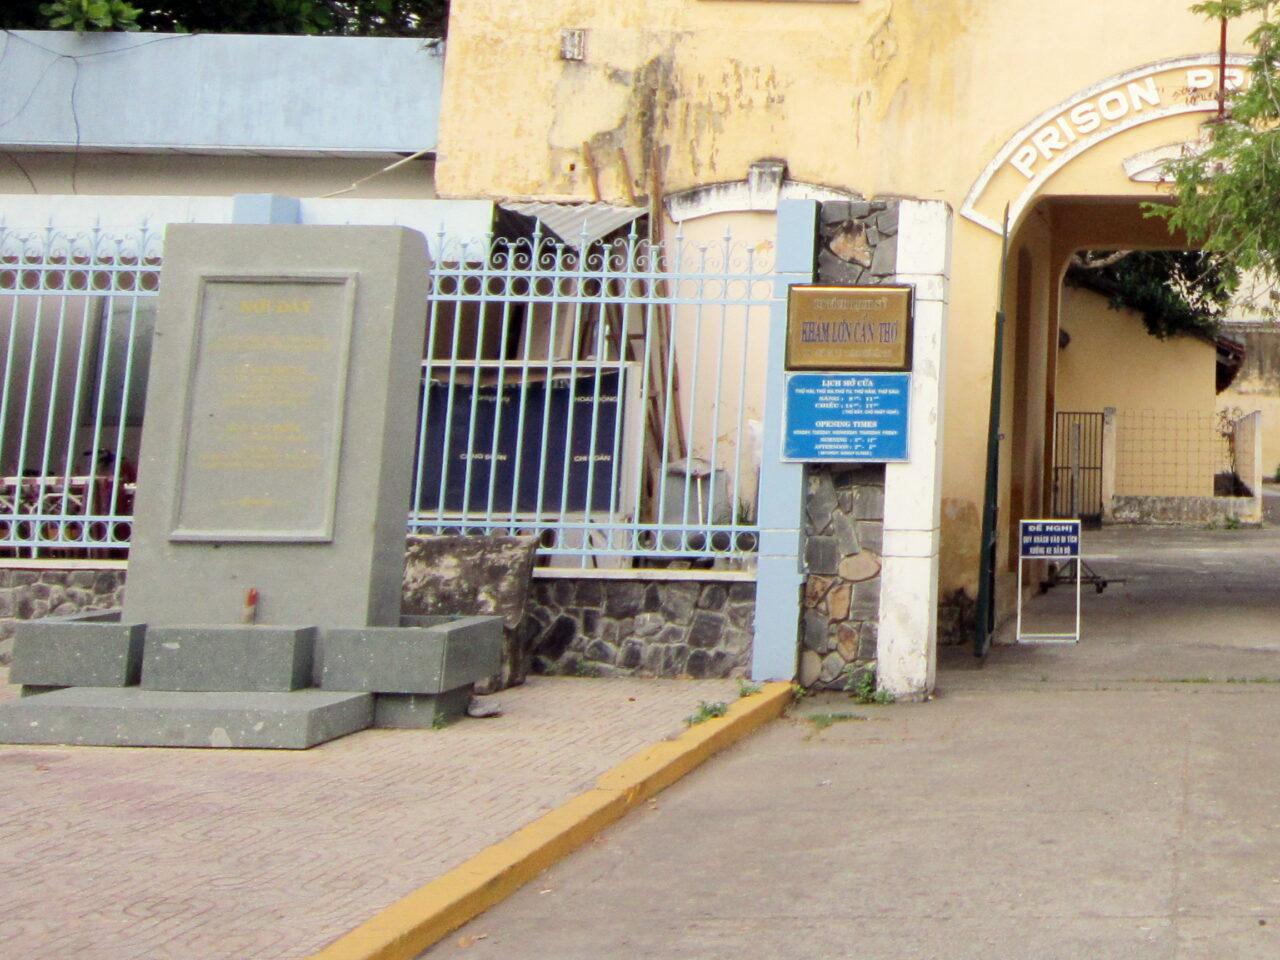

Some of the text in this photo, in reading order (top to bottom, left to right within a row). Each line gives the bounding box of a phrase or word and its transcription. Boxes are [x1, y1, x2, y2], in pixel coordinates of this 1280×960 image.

[1009, 77, 1161, 180] PRISON
[815, 420, 878, 428] OPENING TIMES
